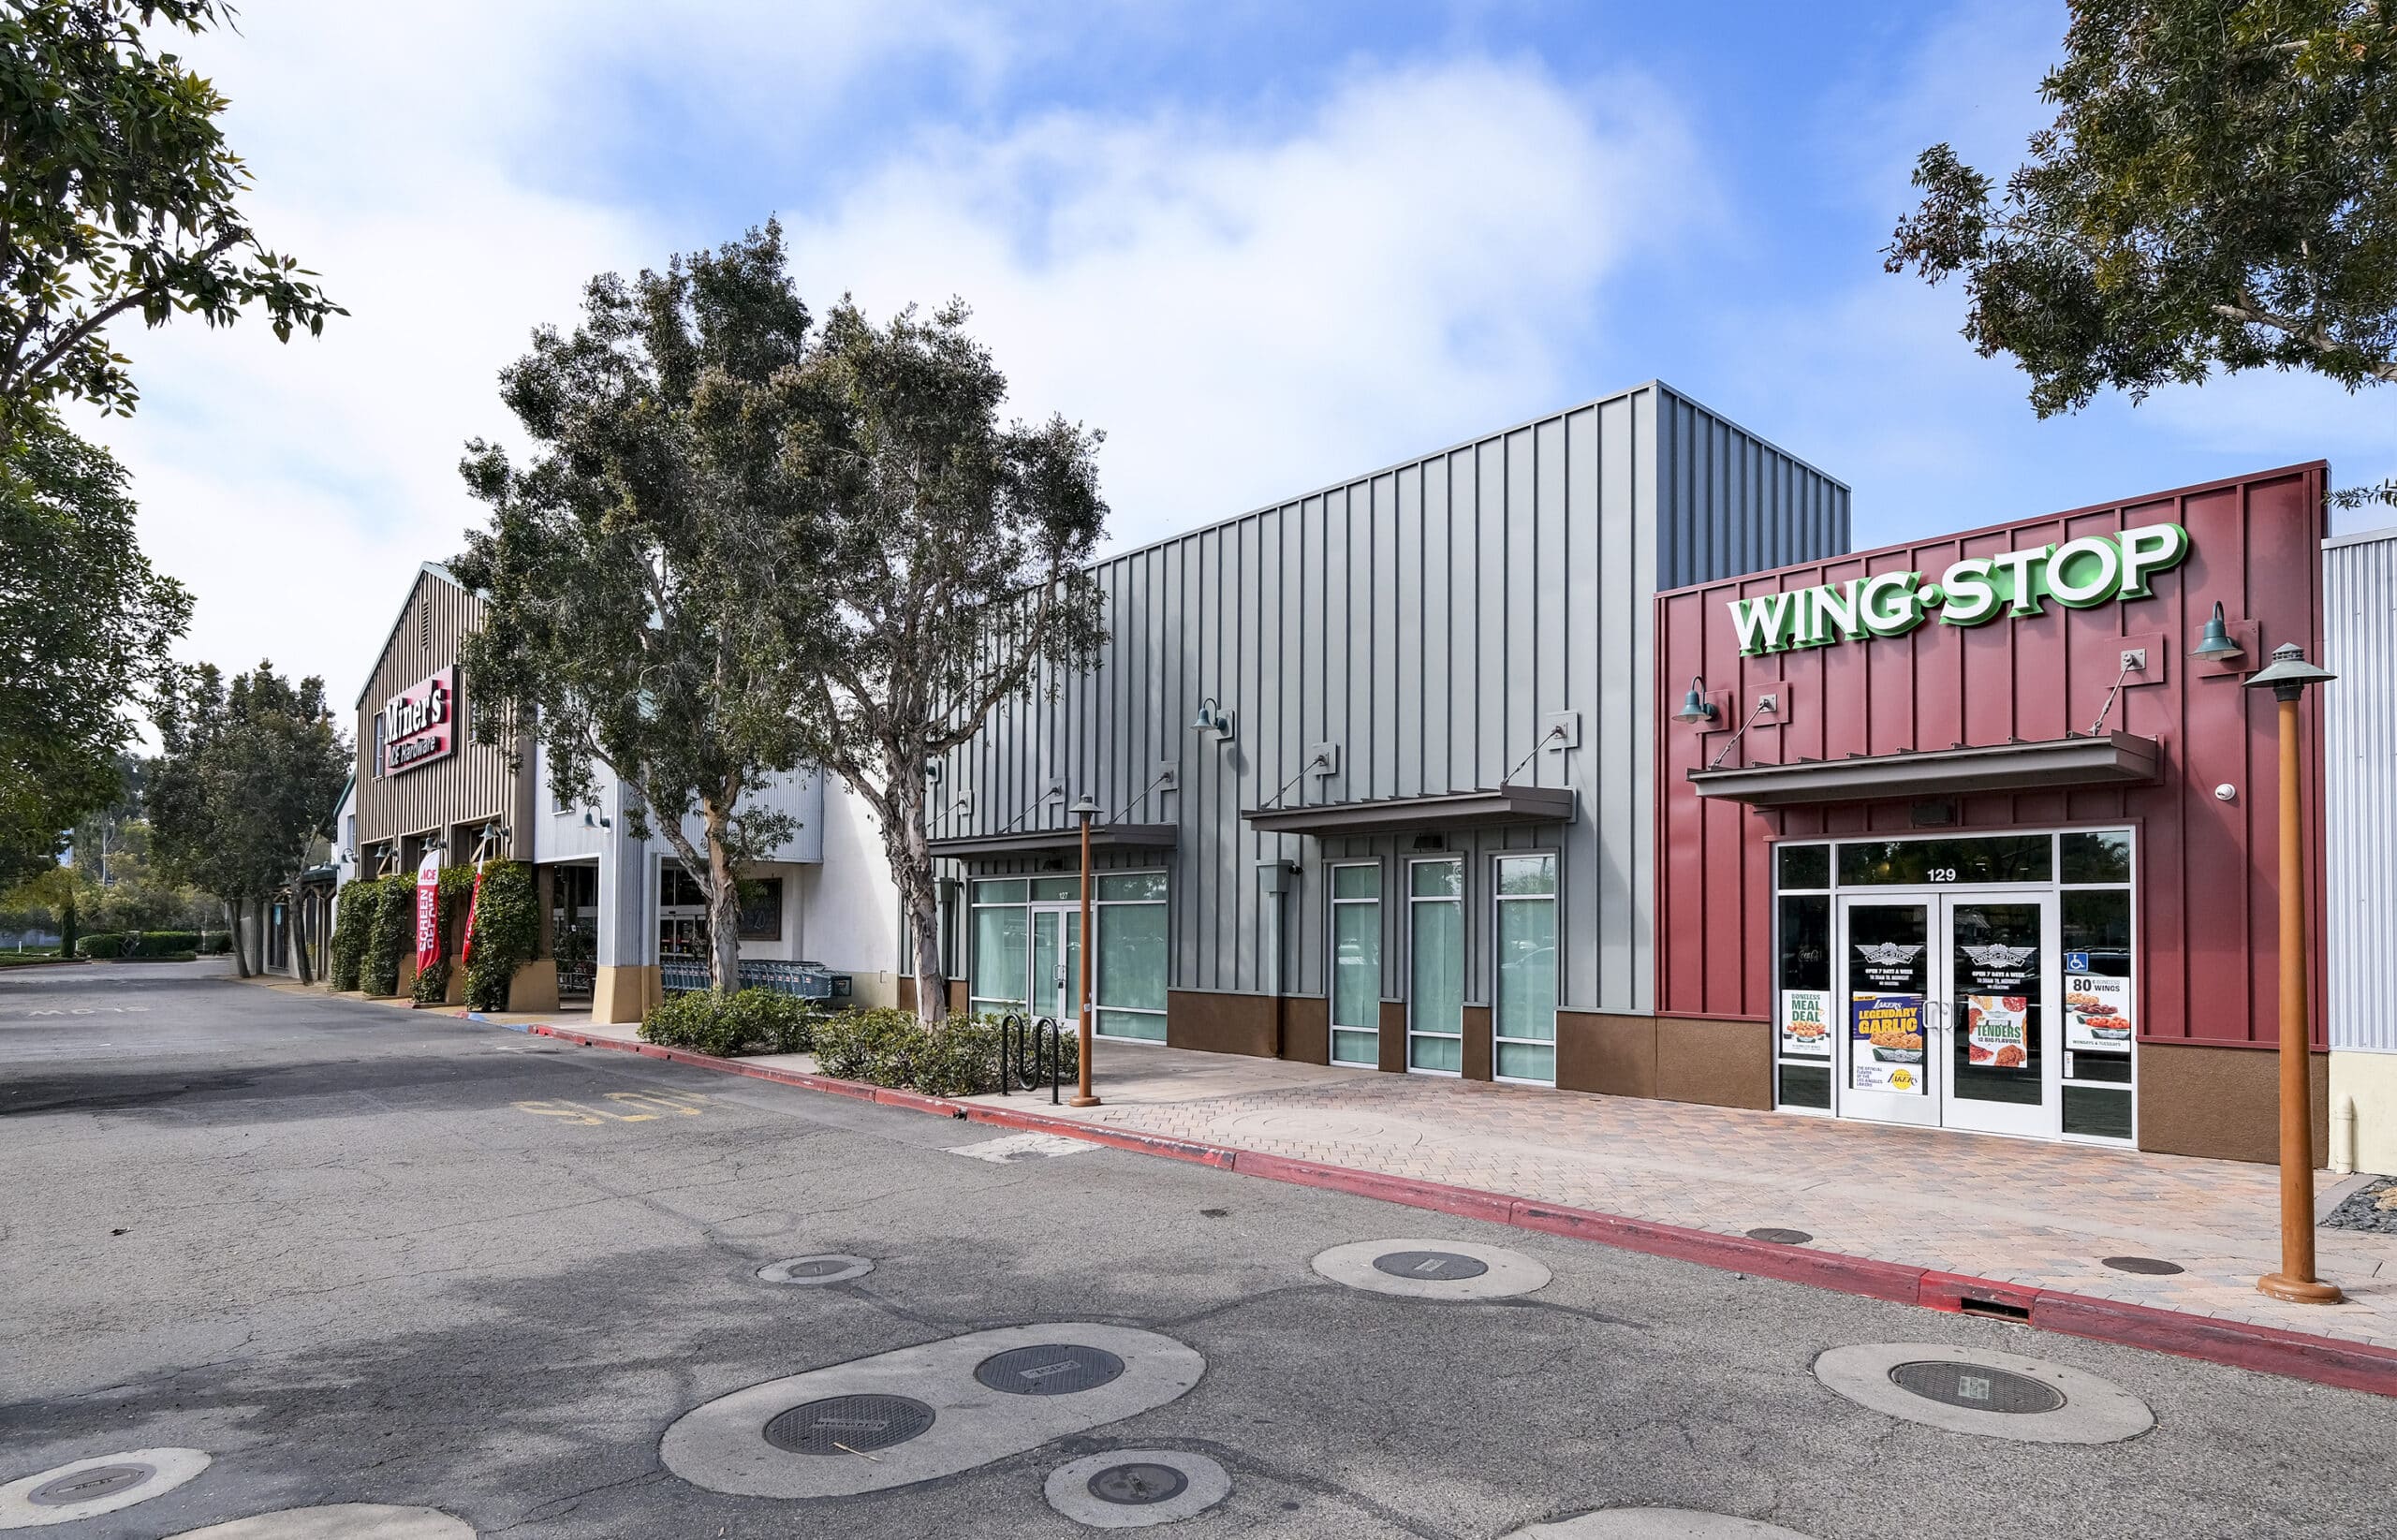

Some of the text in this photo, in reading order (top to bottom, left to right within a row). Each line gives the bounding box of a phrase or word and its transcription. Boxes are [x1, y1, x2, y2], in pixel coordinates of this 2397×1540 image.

[401, 736, 437, 764] Hardware
[420, 869, 436, 881] ACE
[1927, 868, 1956, 882] 129
[1059, 891, 1068, 900] 127
[419, 889, 429, 952] SCREEN
[1791, 1000, 1820, 1011] MEAL
[1792, 1011, 1821, 1022] DEAL
[1859, 1007, 1919, 1019] LEGENDARY
[1858, 1018, 1919, 1034] GARLIC
[1978, 1024, 2022, 1039] TENDERS
